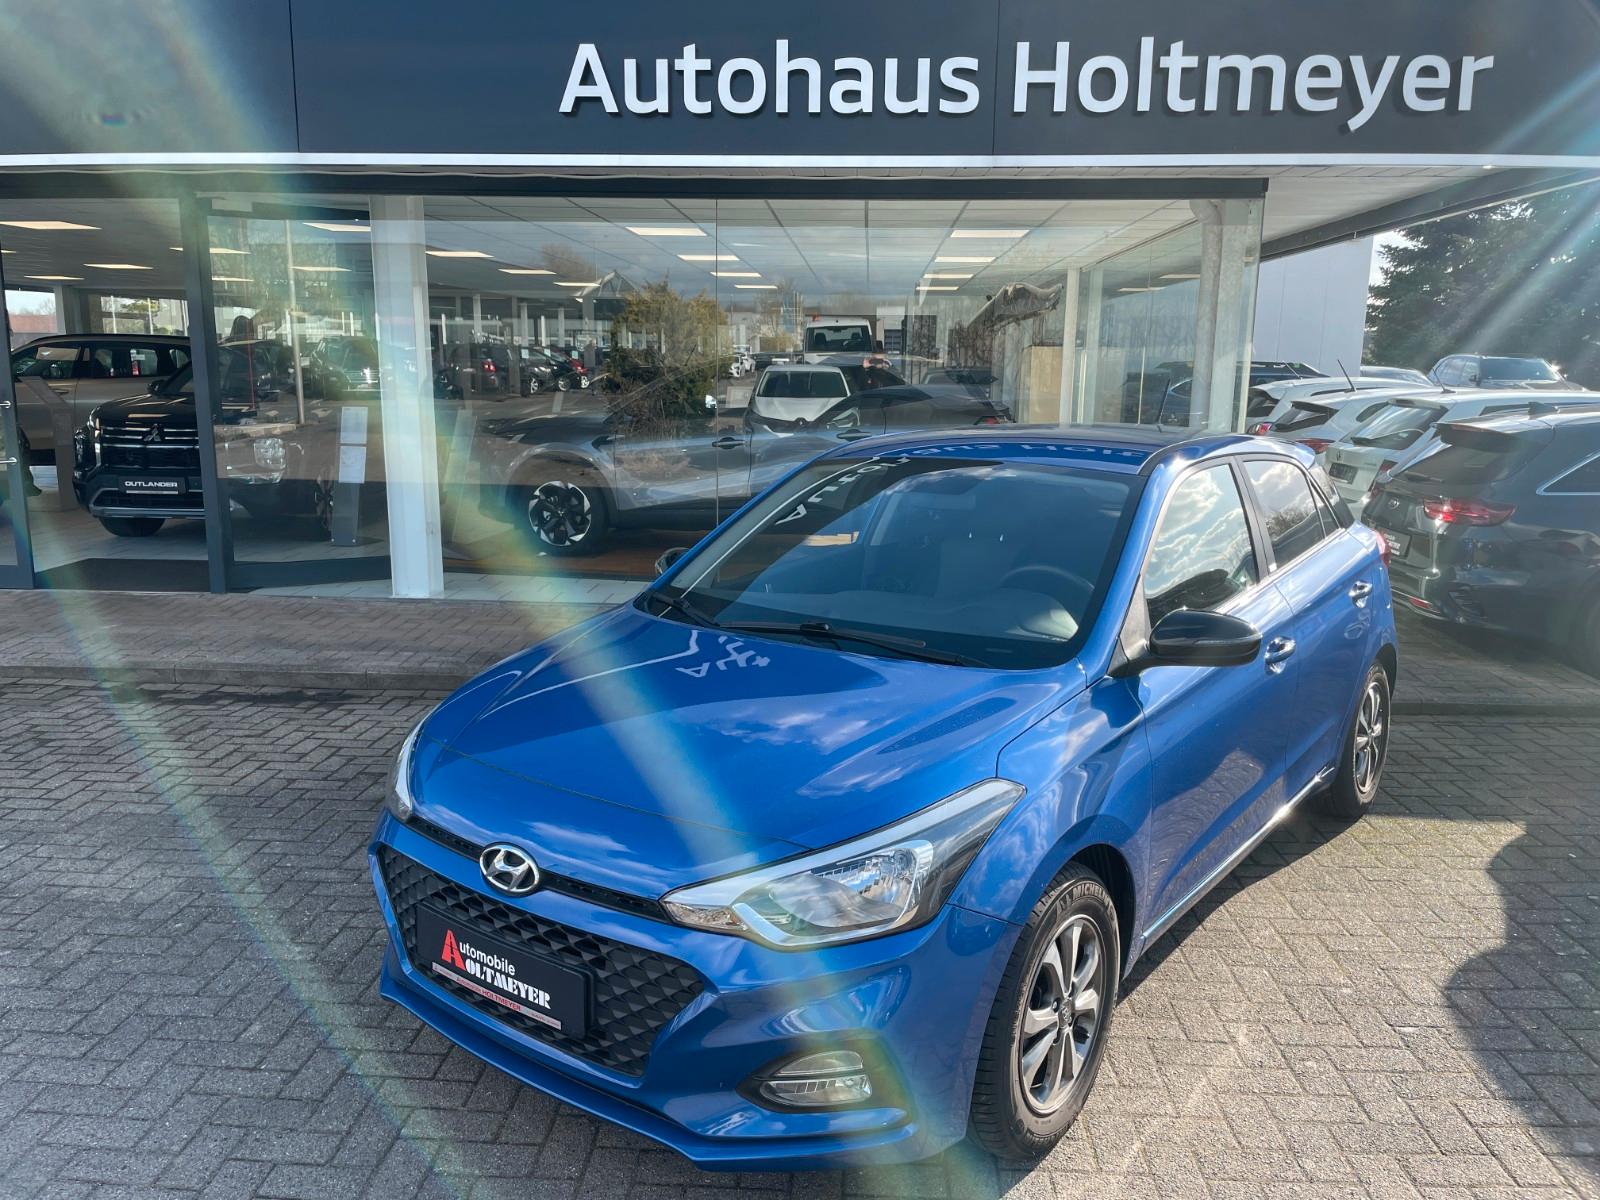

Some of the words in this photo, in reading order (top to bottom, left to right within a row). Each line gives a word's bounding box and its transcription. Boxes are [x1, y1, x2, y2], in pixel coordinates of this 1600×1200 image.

[558, 38, 981, 115] Autohaus
[1013, 36, 1495, 133] Holtmeyer
[124, 480, 178, 488] OUTLANDER
[1072, 882, 1113, 906] MICHELIN
[441, 928, 516, 976] Automobile
[481, 989, 522, 1012] HOLTMEYER
